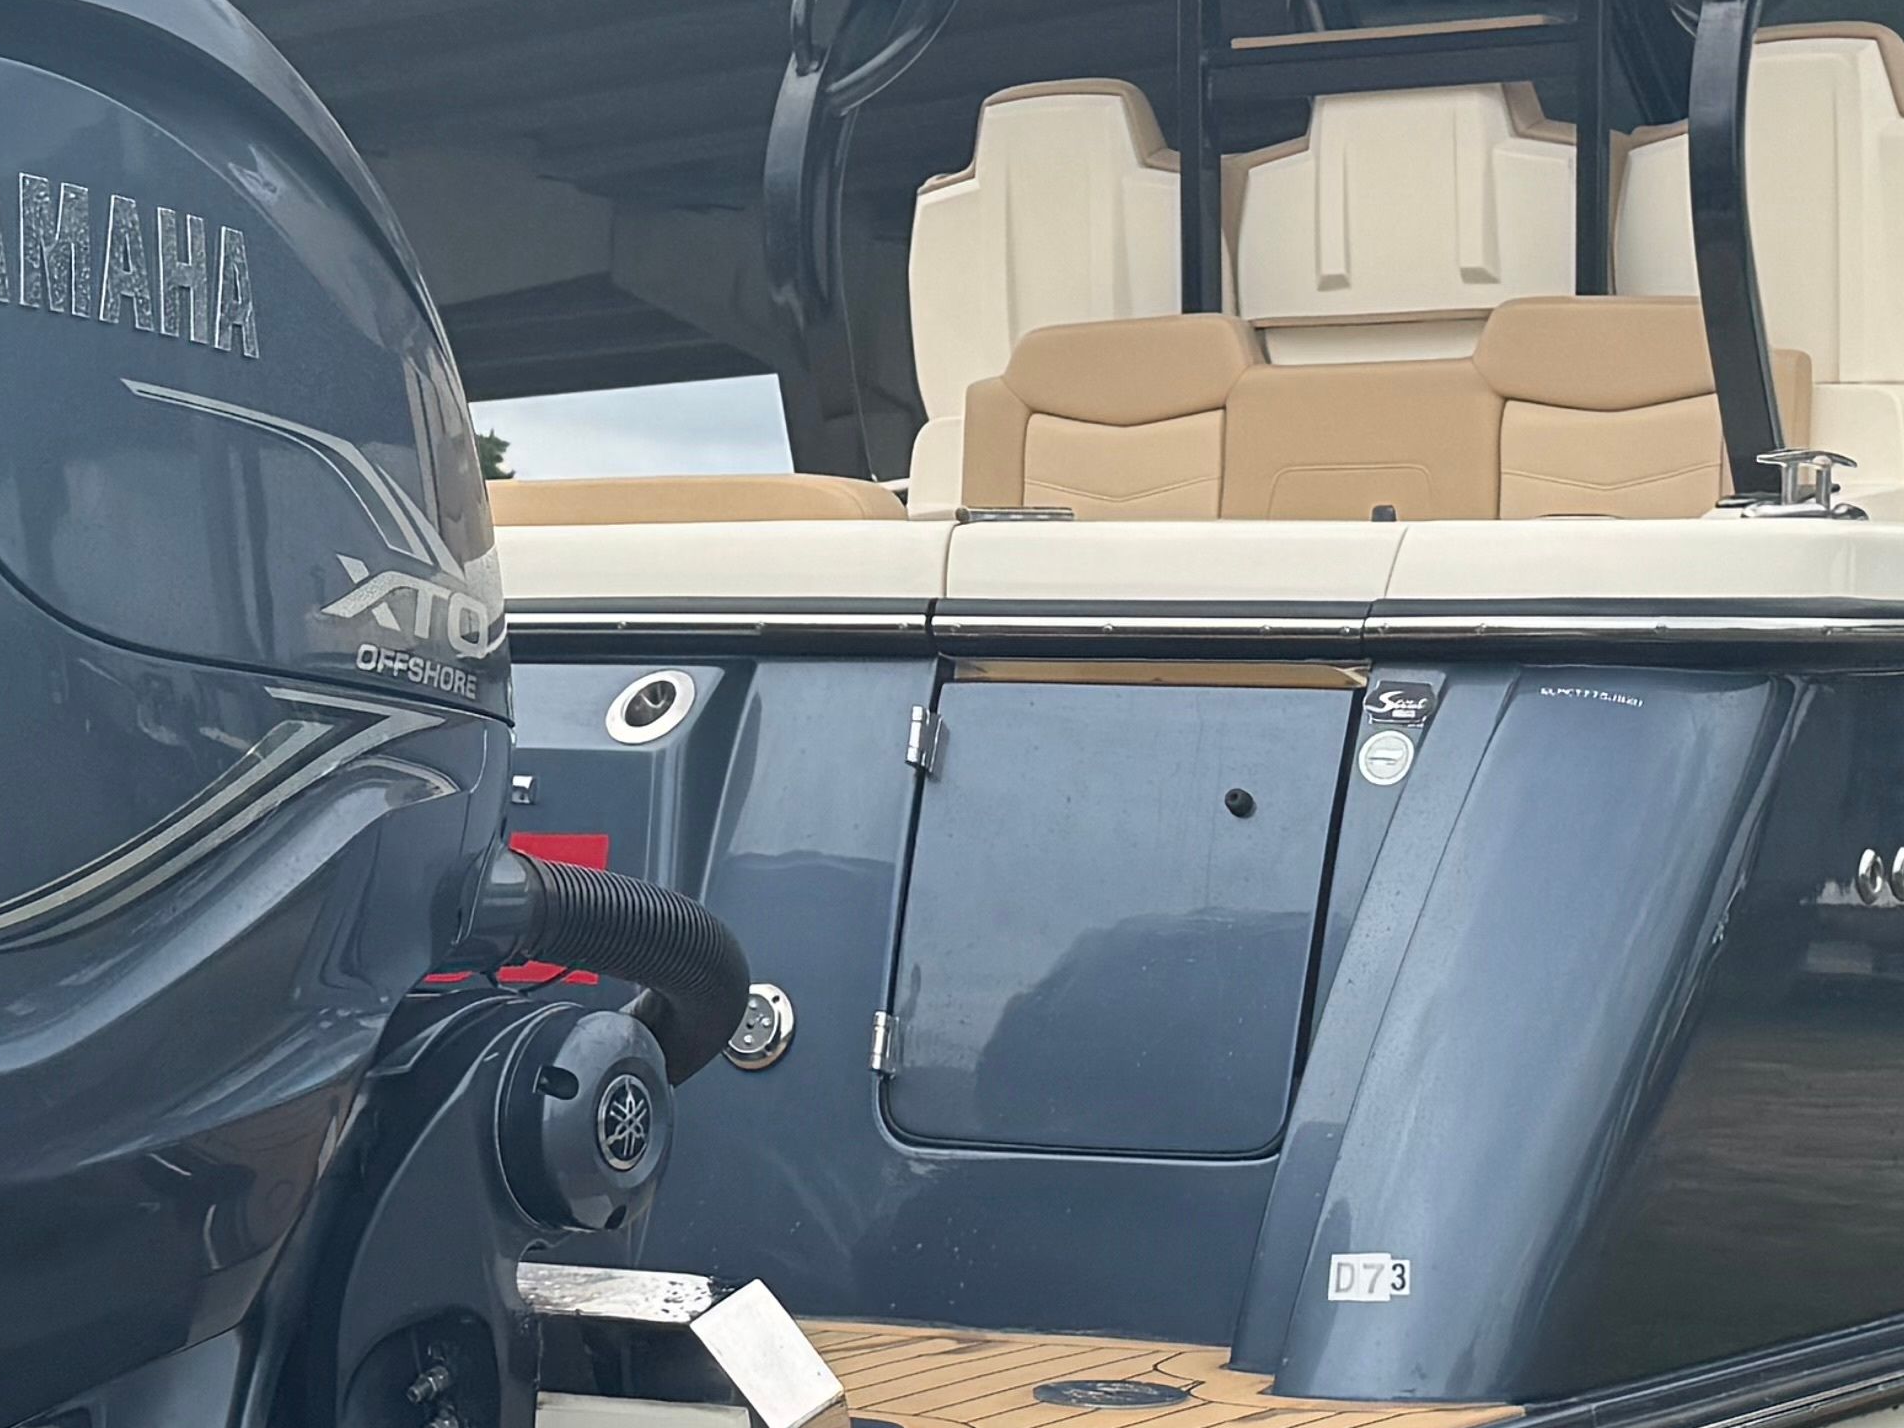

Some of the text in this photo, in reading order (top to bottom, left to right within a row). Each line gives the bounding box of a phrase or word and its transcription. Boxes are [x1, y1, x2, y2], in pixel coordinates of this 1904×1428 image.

[320, 553, 489, 660] XTO
[356, 643, 477, 700] OFFSHORE
[1334, 1261, 1407, 1294] D73
